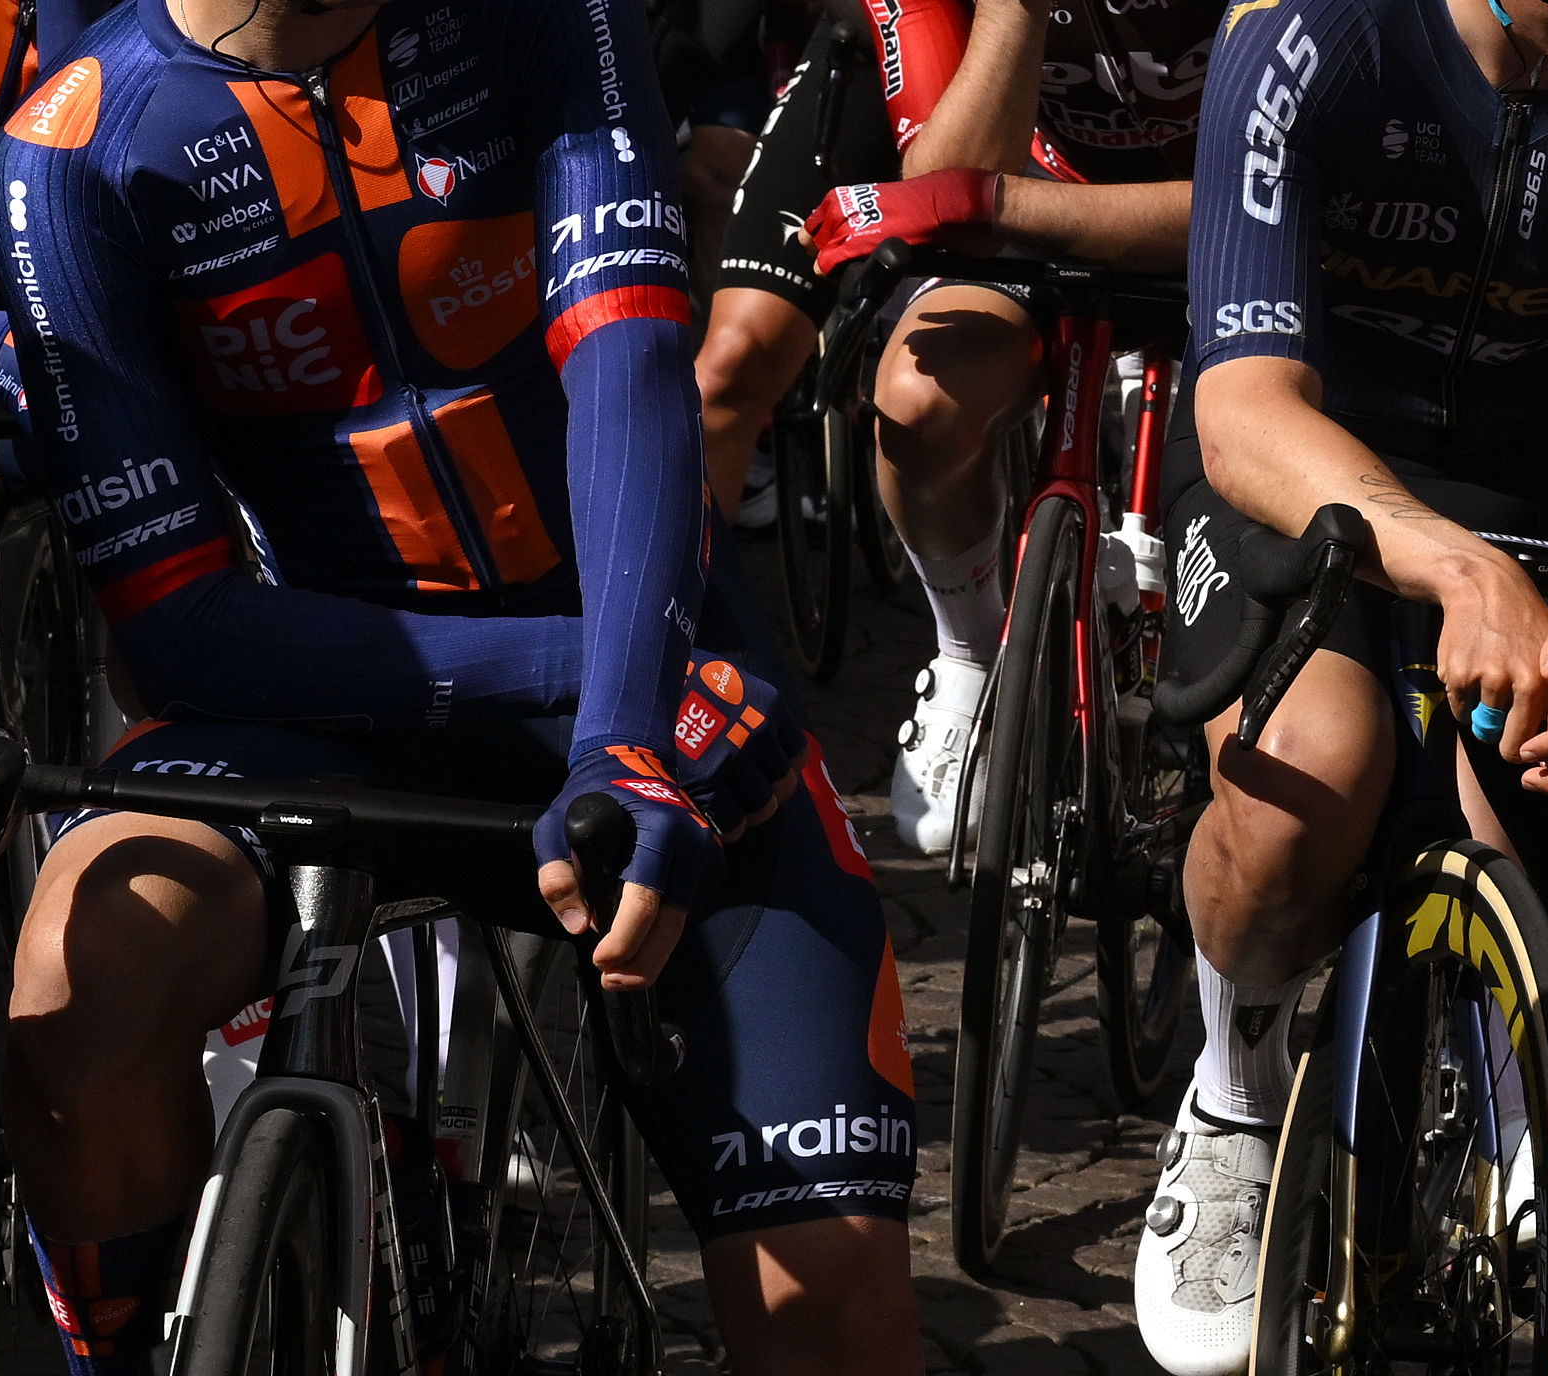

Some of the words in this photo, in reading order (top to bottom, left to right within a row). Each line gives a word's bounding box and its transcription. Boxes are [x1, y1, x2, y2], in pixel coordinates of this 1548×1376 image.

[425, 6, 452, 29] UCI
[426, 13, 469, 46] WORLD
[428, 33, 463, 55] TEAM
[32, 64, 93, 137] postnl
[426, 87, 490, 127] MICHELIN
[183, 125, 254, 166] IG&H
[1414, 135, 1441, 150] PRO
[1415, 121, 1442, 135] UCI
[1414, 149, 1447, 166] TEAM
[188, 165, 265, 204] VAYA
[200, 198, 274, 234] webex
[1367, 202, 1460, 244] UBS
[169, 235, 280, 281] LAPIERRE
[1215, 299, 1305, 338] SGS
[11, 240, 80, 445] dsm-firmenich
[1060, 341, 1083, 452] ORBEA
[760, 1103, 914, 1161] raisin
[711, 1175, 912, 1218] LAPIERRE
